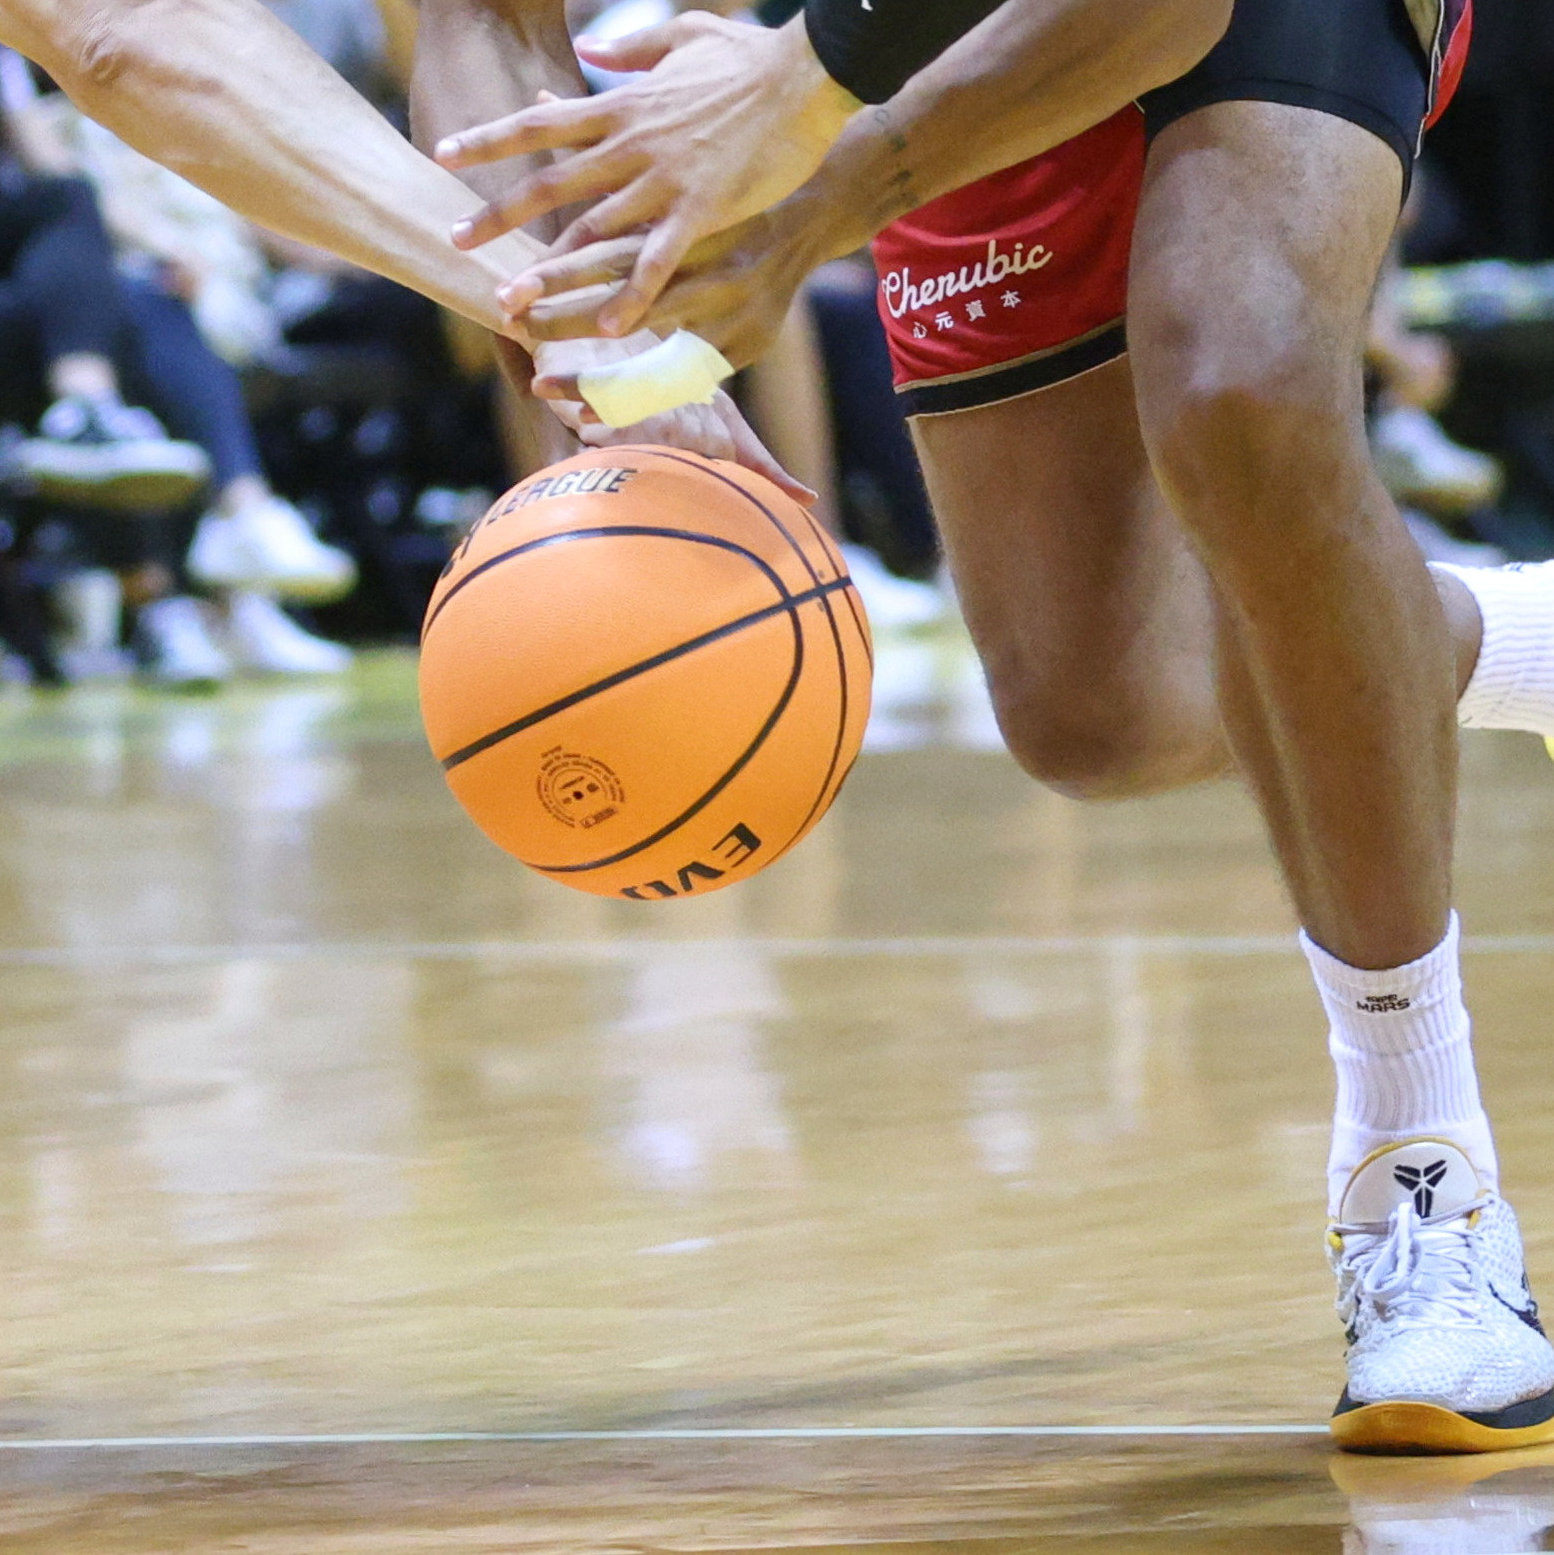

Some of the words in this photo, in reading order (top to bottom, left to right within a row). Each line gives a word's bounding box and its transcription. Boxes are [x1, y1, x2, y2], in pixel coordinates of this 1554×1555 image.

[881, 239, 1053, 319] Cherubic
[912, 290, 1022, 339] 心元資本
[1356, 998, 1411, 1014] MARS
